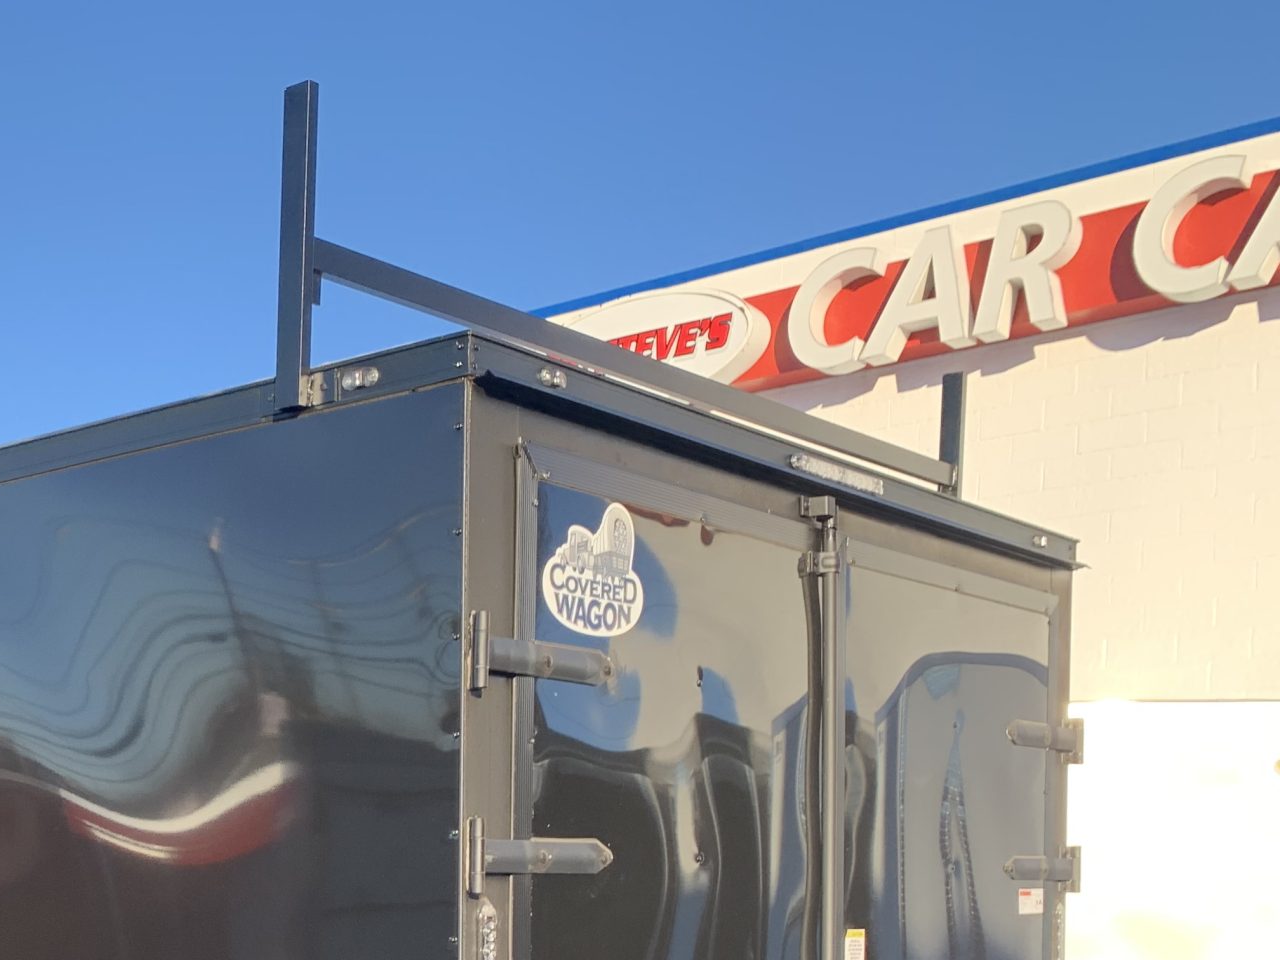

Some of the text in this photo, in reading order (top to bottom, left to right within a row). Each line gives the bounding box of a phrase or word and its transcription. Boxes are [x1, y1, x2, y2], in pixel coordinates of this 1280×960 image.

[787, 200, 1083, 376] CAR
[607, 312, 733, 361] TEVE'S
[550, 563, 637, 604] COVERED
[554, 591, 631, 632] WAGON
